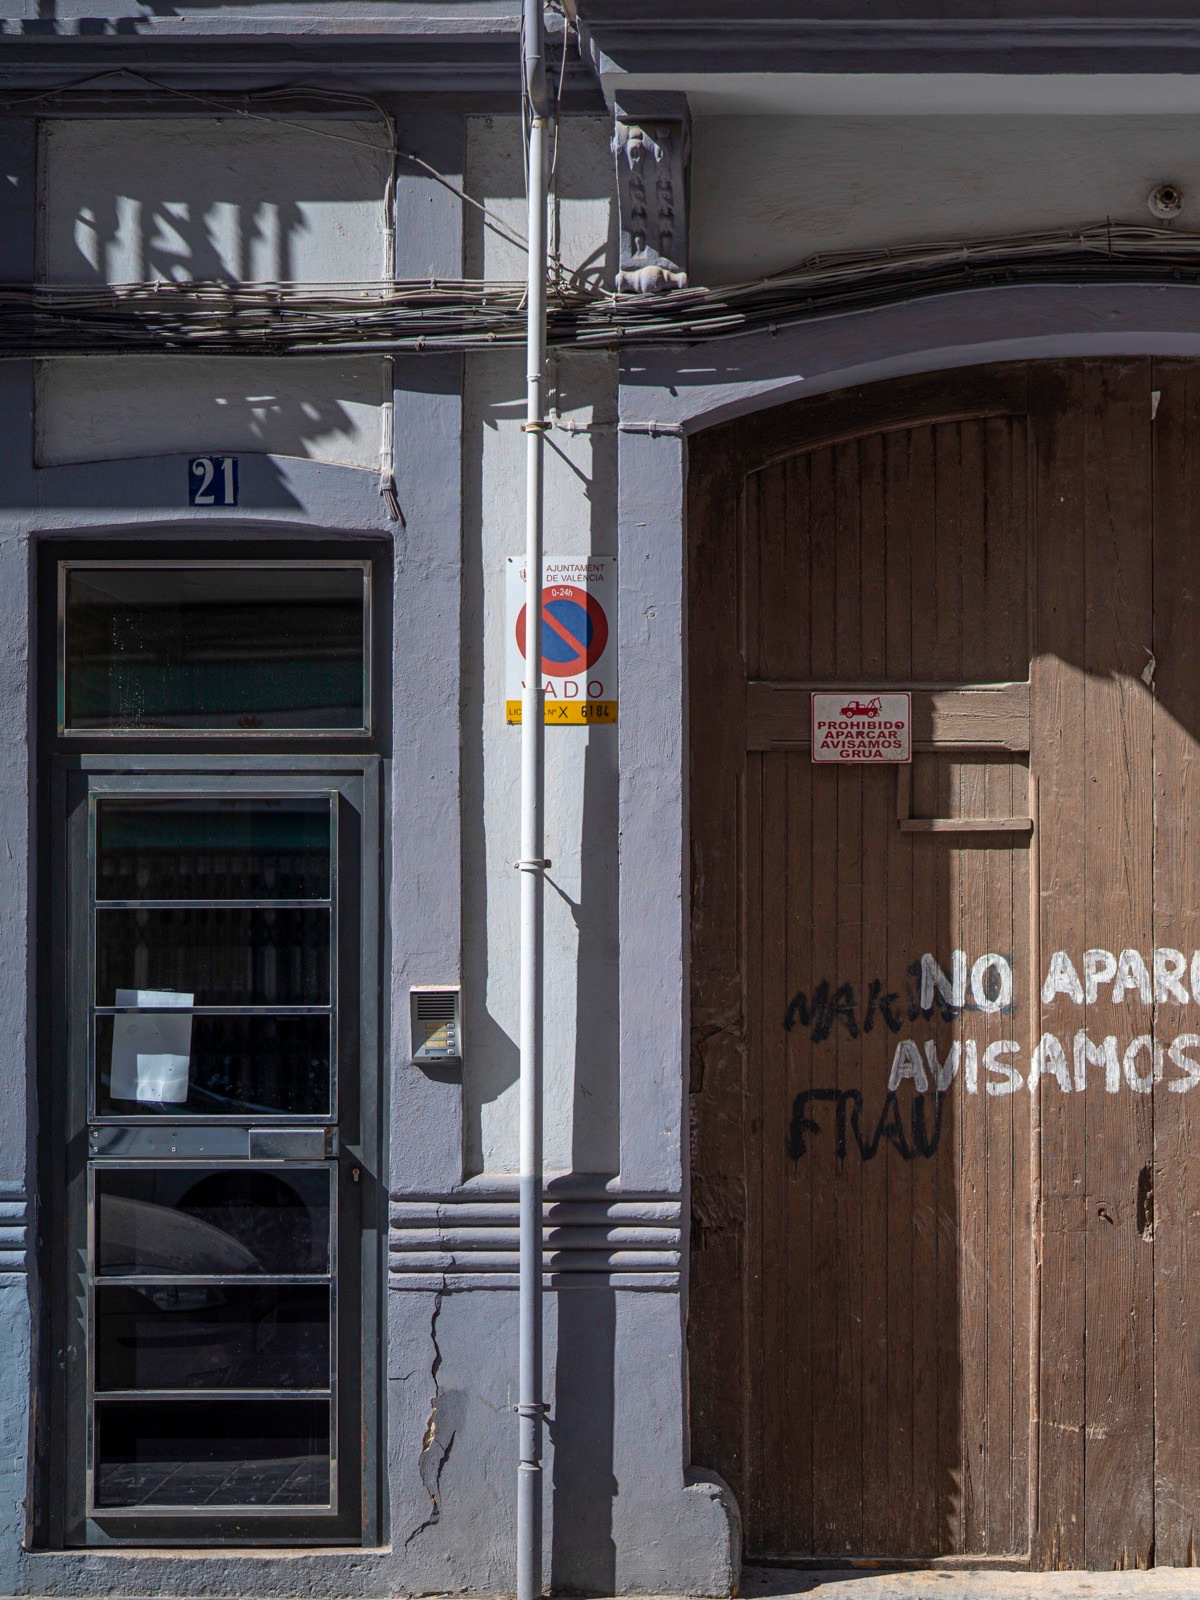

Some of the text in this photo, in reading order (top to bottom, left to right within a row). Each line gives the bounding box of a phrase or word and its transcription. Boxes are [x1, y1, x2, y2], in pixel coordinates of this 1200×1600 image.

[192, 457, 235, 504] 21
[546, 564, 605, 572] AJUNTAMENT
[546, 574, 559, 582] DE
[551, 587, 573, 597] 0-24h
[521, 680, 604, 699] ADO
[558, 706, 569, 719] X
[581, 705, 610, 718] 6184
[817, 721, 905, 730] PROHIBIDO
[824, 730, 898, 739] APARCAR
[820, 740, 902, 749] AVISAMOS
[839, 749, 884, 758] GRUA
[919, 949, 1014, 1014] NO
